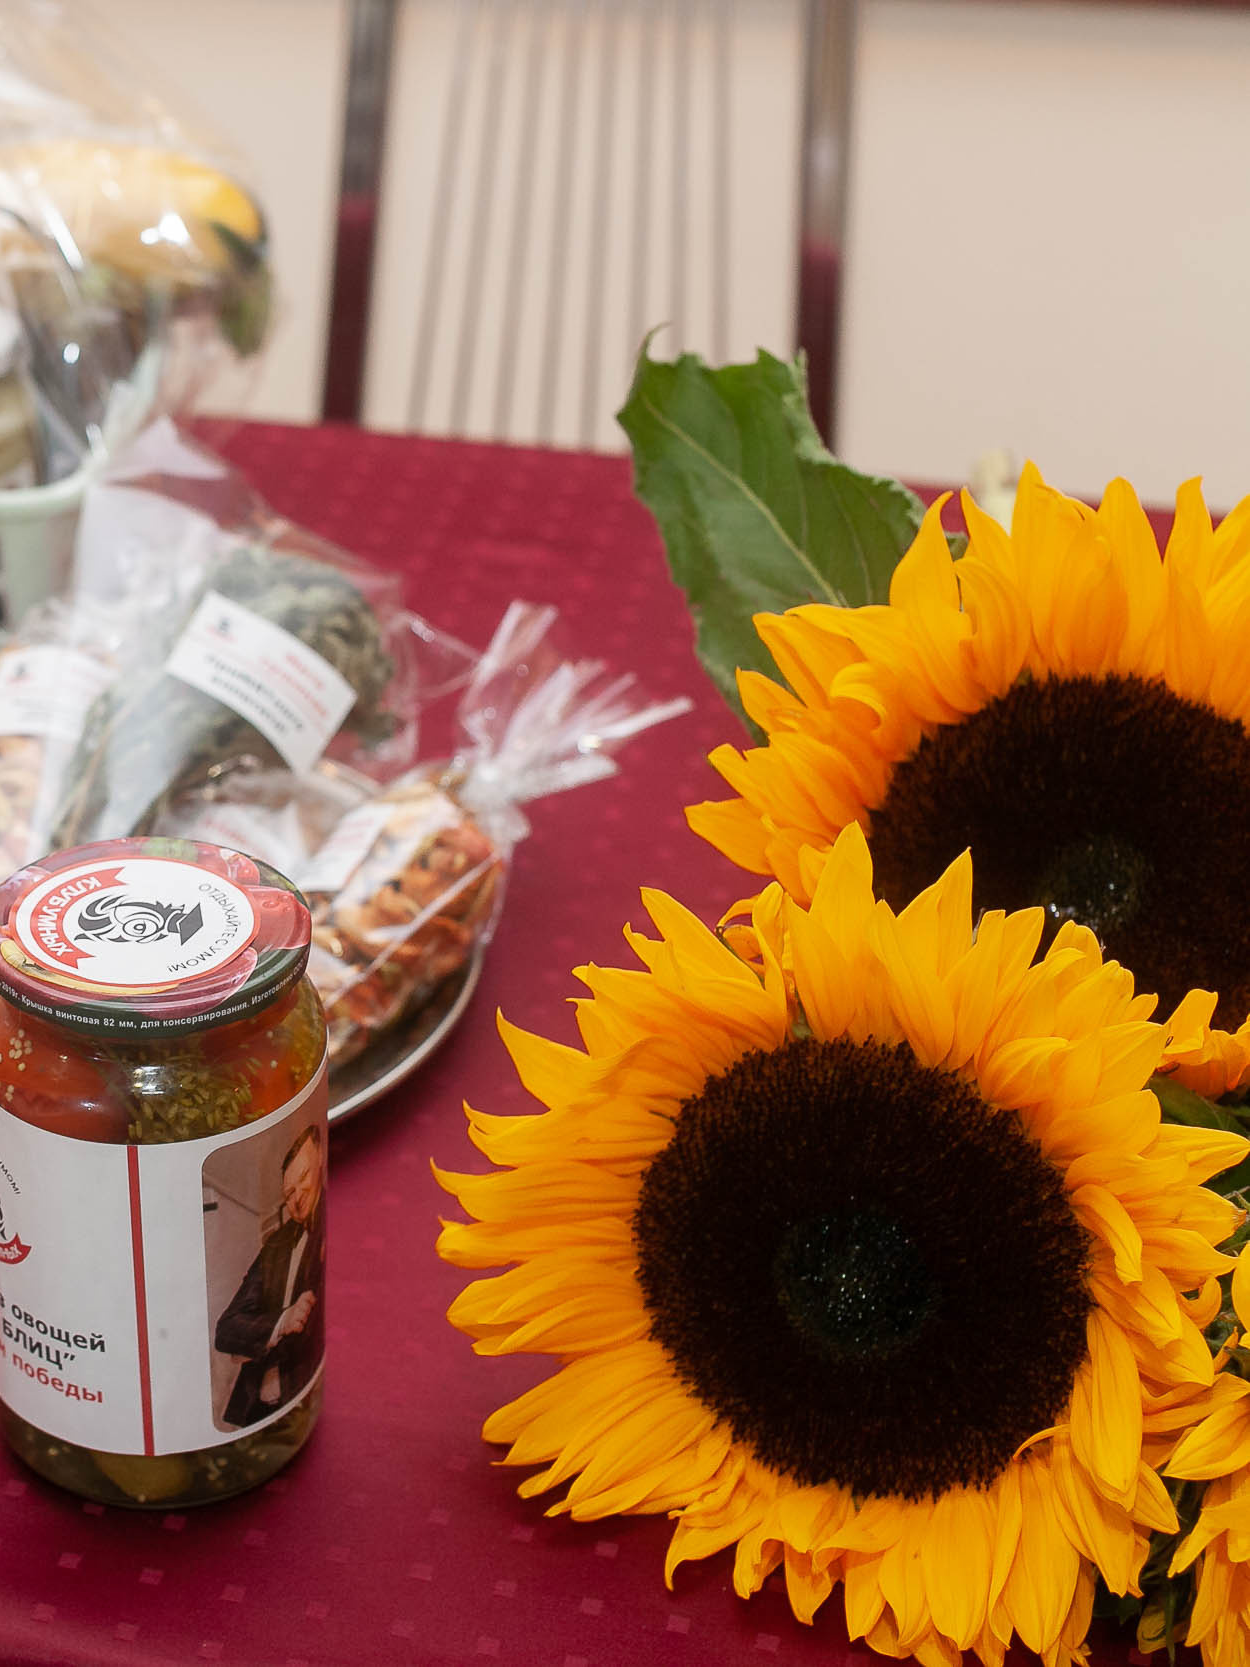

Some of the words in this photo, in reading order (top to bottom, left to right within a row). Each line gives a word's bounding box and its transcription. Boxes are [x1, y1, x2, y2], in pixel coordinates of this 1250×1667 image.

[48, 876, 102, 908] КЛУБ
[198, 883, 241, 938] ОТДЫХАЙТЕ
[37, 905, 75, 957] УМНЫХ
[167, 946, 222, 973] УМОМ!
[21, 994, 54, 1015] Крышка
[55, 1009, 100, 1025] винтовая
[103, 1018, 115, 1027] 82
[118, 1021, 138, 1029] мм,
[140, 1020, 160, 1029] для
[162, 1002, 250, 1028] консервирования.
[251, 973, 293, 1005] Изготовлено
[11, 1304, 106, 1353] овощей
[12, 1353, 104, 1404] победы
